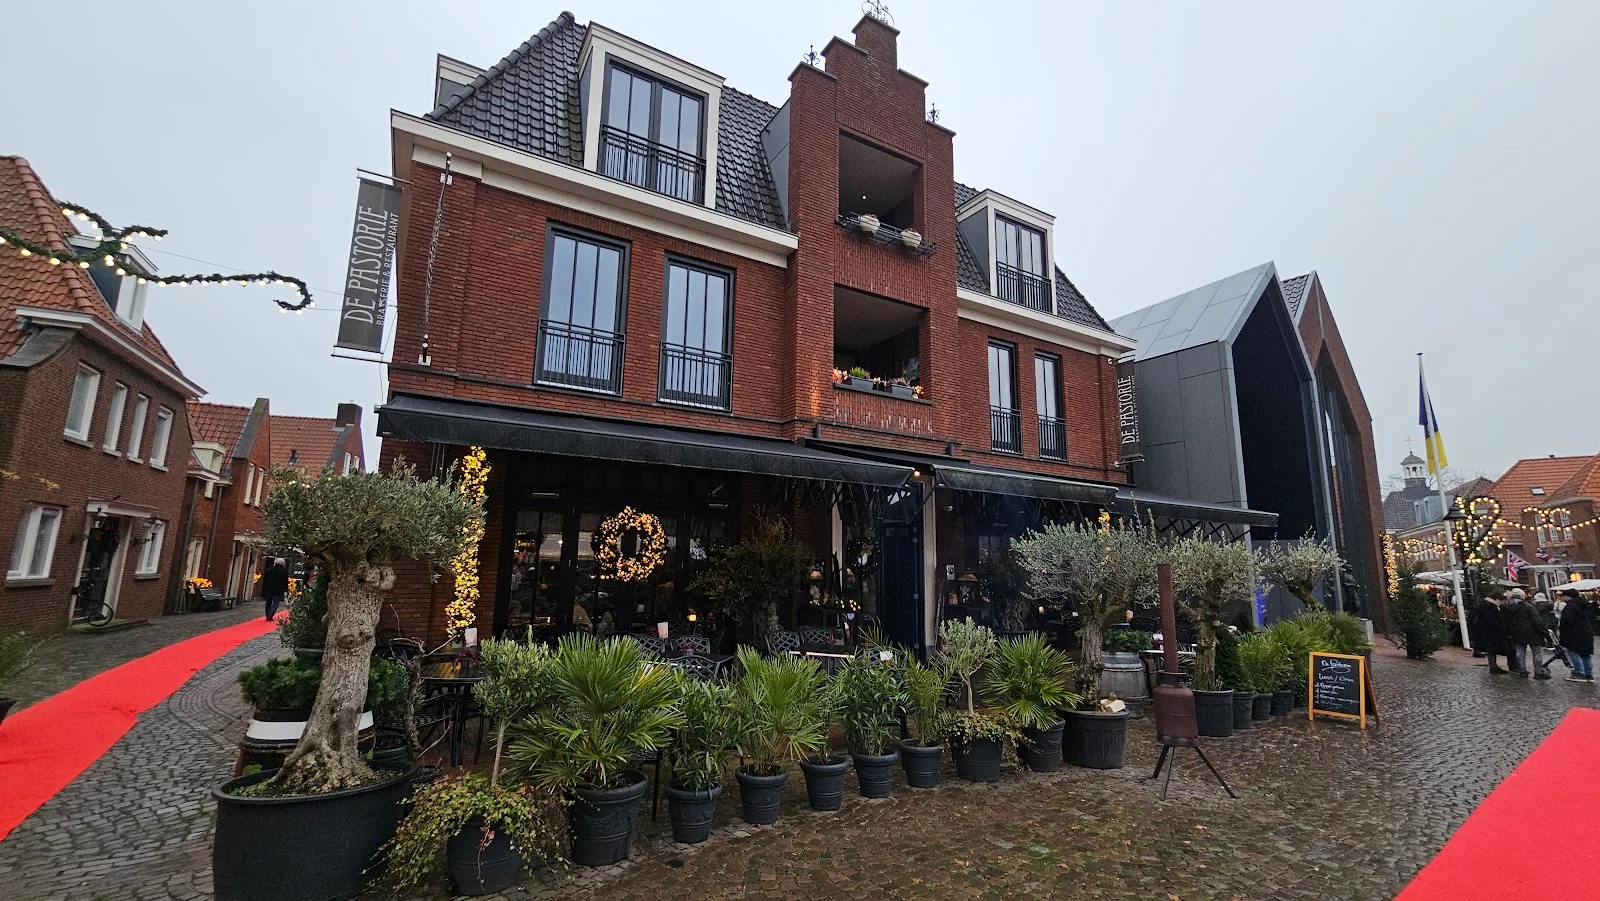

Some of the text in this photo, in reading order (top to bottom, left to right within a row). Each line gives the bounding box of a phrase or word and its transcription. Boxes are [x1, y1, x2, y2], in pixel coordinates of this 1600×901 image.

[344, 205, 389, 324] DE PASTORIE
[376, 212, 399, 326] BRASSERIE & RESTAURANT
[1117, 375, 1136, 444] DE PASTORIE
